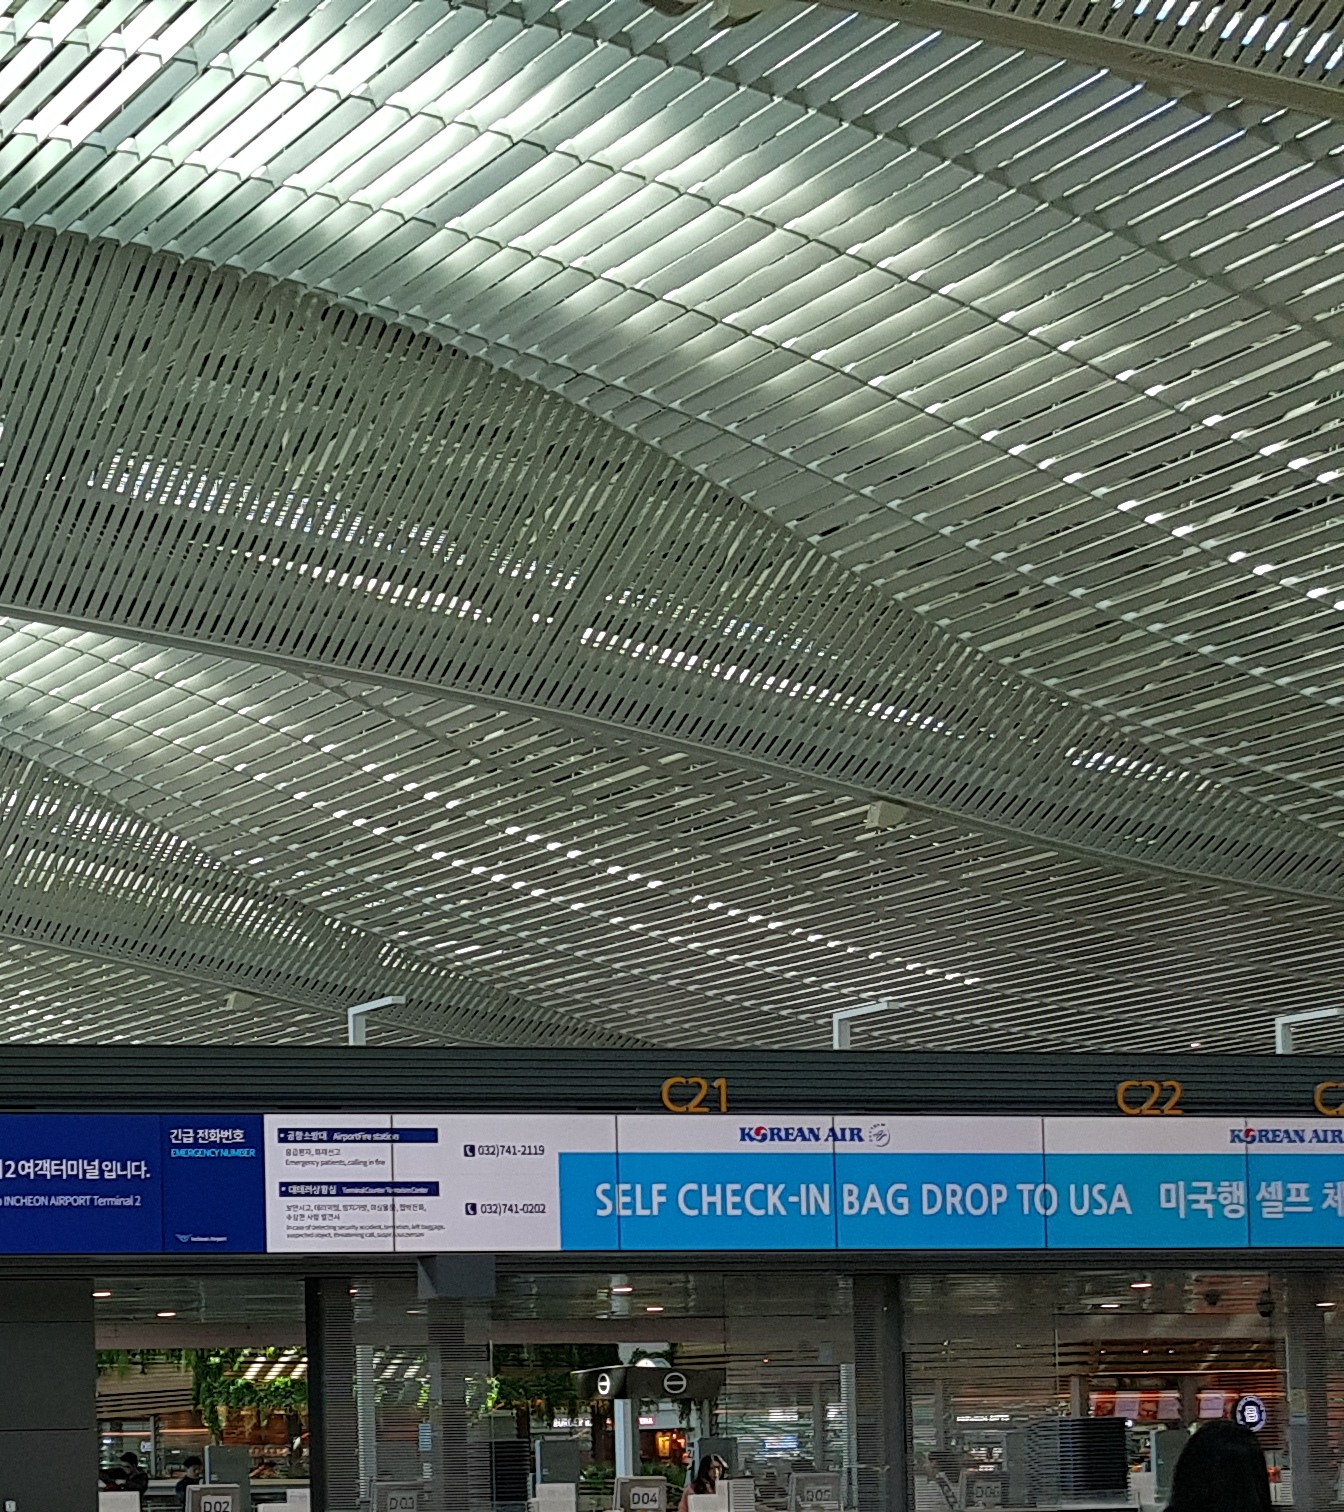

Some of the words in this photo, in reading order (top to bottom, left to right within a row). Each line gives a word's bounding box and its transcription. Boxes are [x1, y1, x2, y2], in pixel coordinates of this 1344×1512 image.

[662, 1077, 728, 1112] C21
[1117, 1080, 1184, 1115] C22
[170, 1128, 194, 1144] 긴급
[196, 1128, 245, 1144] 전화번호
[739, 1125, 822, 1143] KOREAN
[823, 1126, 865, 1143] AIR
[1229, 1128, 1306, 1145] KOREAN
[1308, 1129, 1344, 1144] AIR
[171, 1148, 220, 1158] EMERGENCY
[220, 1148, 256, 1158] NUMBER
[478, 1144, 545, 1158] 032)741-2119
[4, 1195, 49, 1207] INCHEON
[50, 1195, 93, 1207] AIRPORT
[93, 1195, 134, 1207] Terminal
[135, 1195, 142, 1207] 2
[595, 1183, 667, 1217] SELF
[677, 1183, 831, 1217] CHECK-IN
[843, 1183, 910, 1217] BAG
[921, 1183, 1008, 1217] DROP
[1016, 1183, 1059, 1217] TO
[1069, 1183, 1133, 1217] USA
[1159, 1180, 1246, 1219] 미국행
[1255, 1180, 1314, 1219] 셀프
[480, 1203, 547, 1216] 032)741-0202
[631, 1493, 658, 1505] D04
